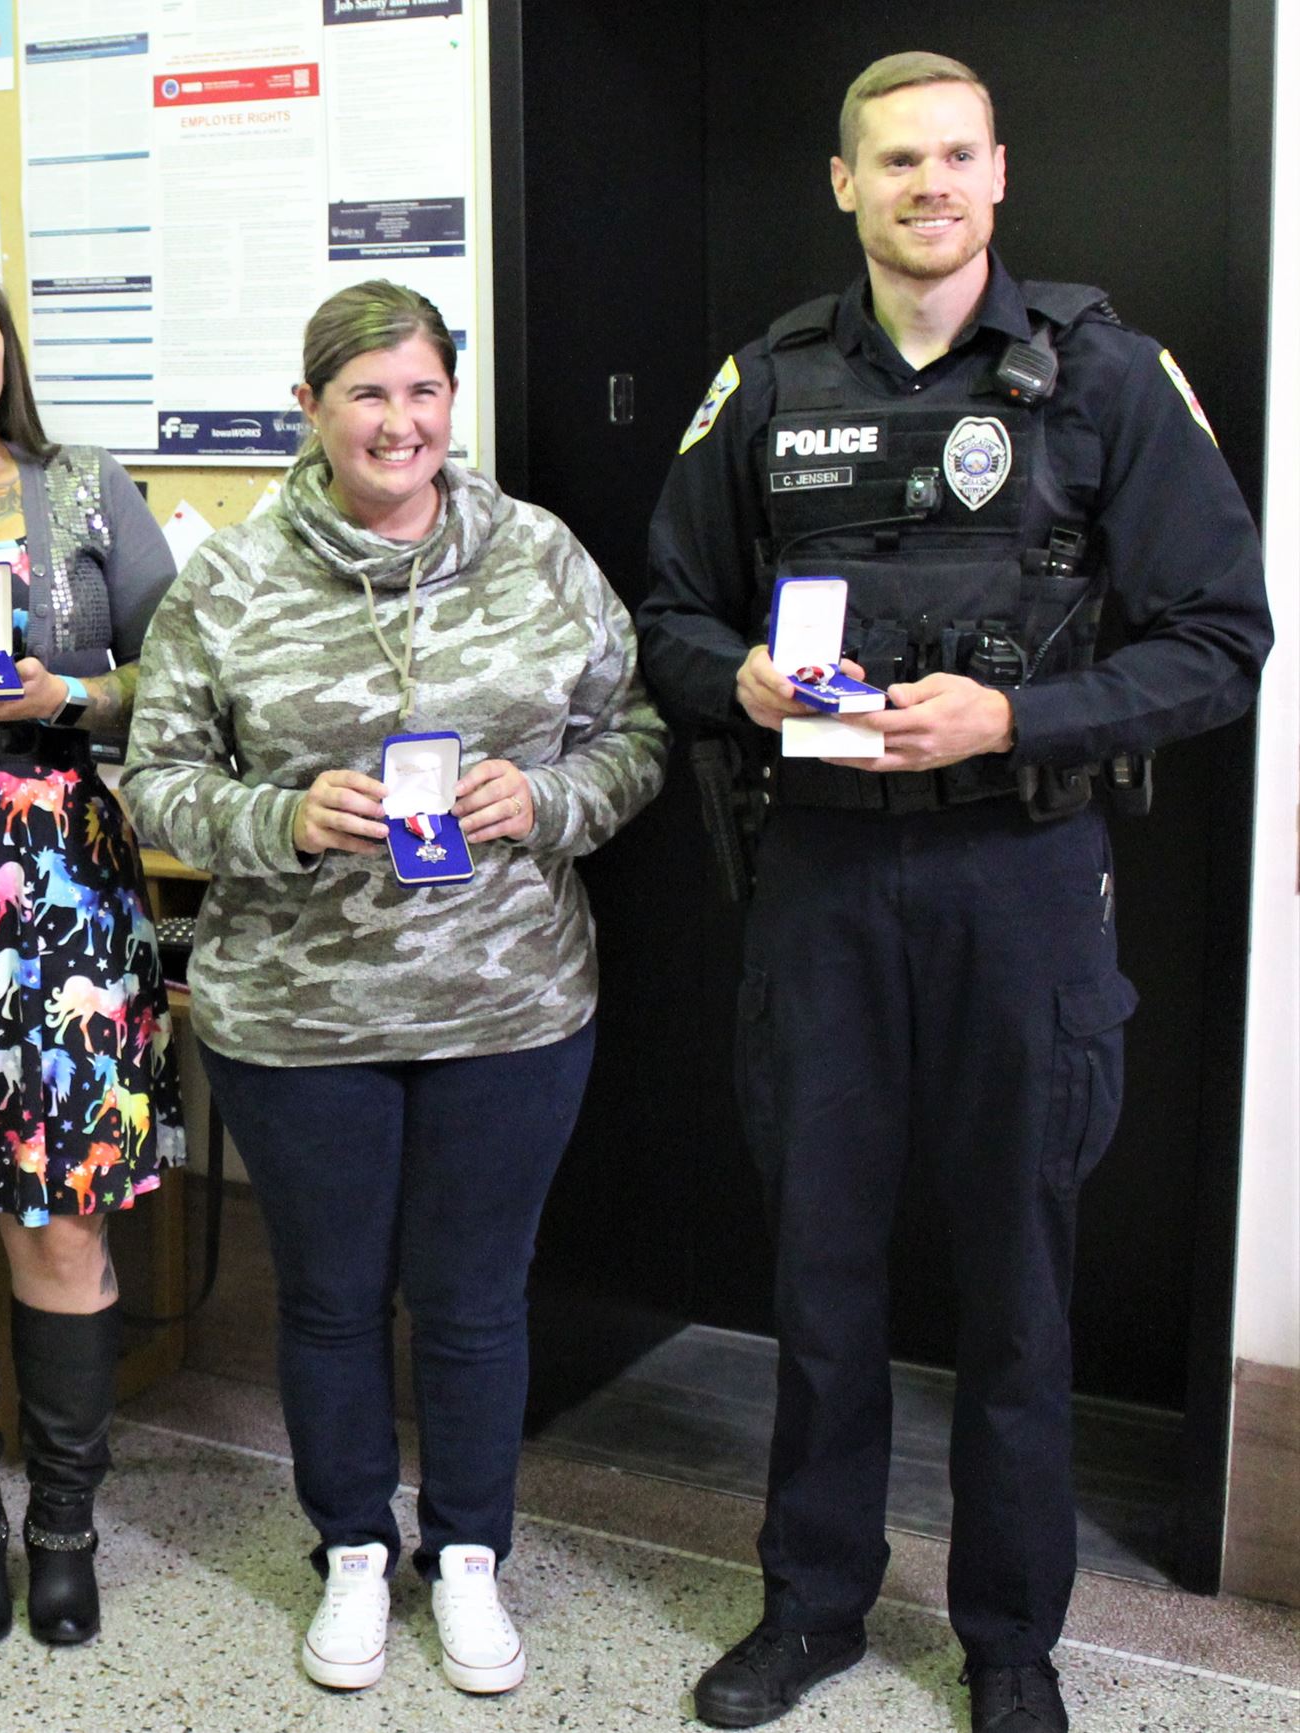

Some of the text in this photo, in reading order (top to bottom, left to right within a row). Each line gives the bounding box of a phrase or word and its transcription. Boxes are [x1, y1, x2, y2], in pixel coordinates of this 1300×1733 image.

[180, 109, 291, 129] EMPLOYEE RIGHTS
[775, 426, 879, 457] POLICE
[782, 471, 839, 487] C. JENSEN
